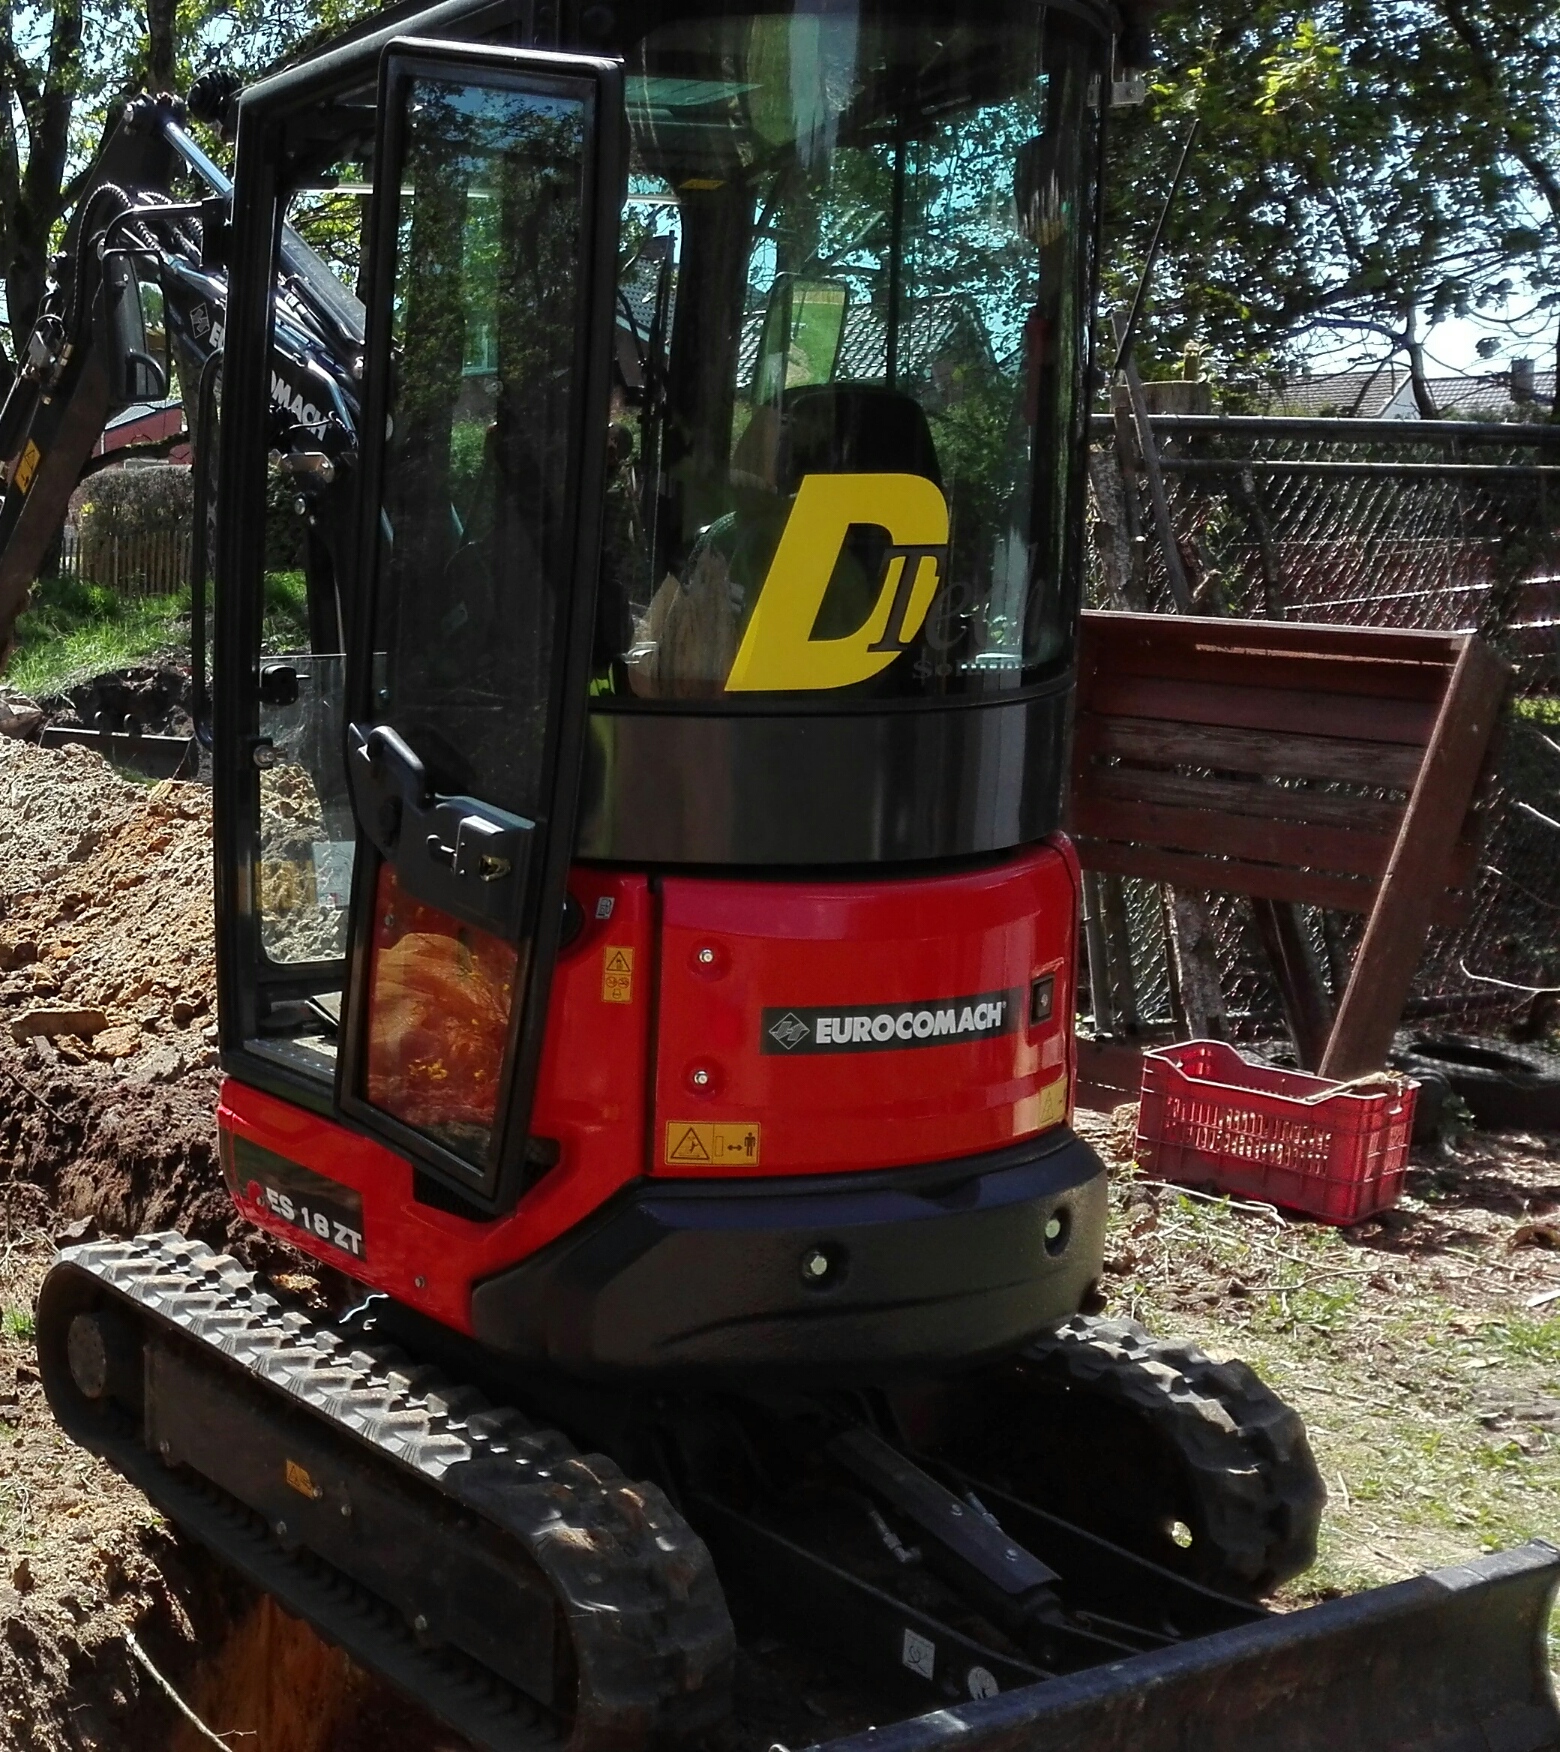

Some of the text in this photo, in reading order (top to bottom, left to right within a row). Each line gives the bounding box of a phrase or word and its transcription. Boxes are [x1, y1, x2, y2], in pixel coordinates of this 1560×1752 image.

[815, 1002, 1003, 1044] EUROCOMACH
[265, 1187, 362, 1255] ES 18 ZT
